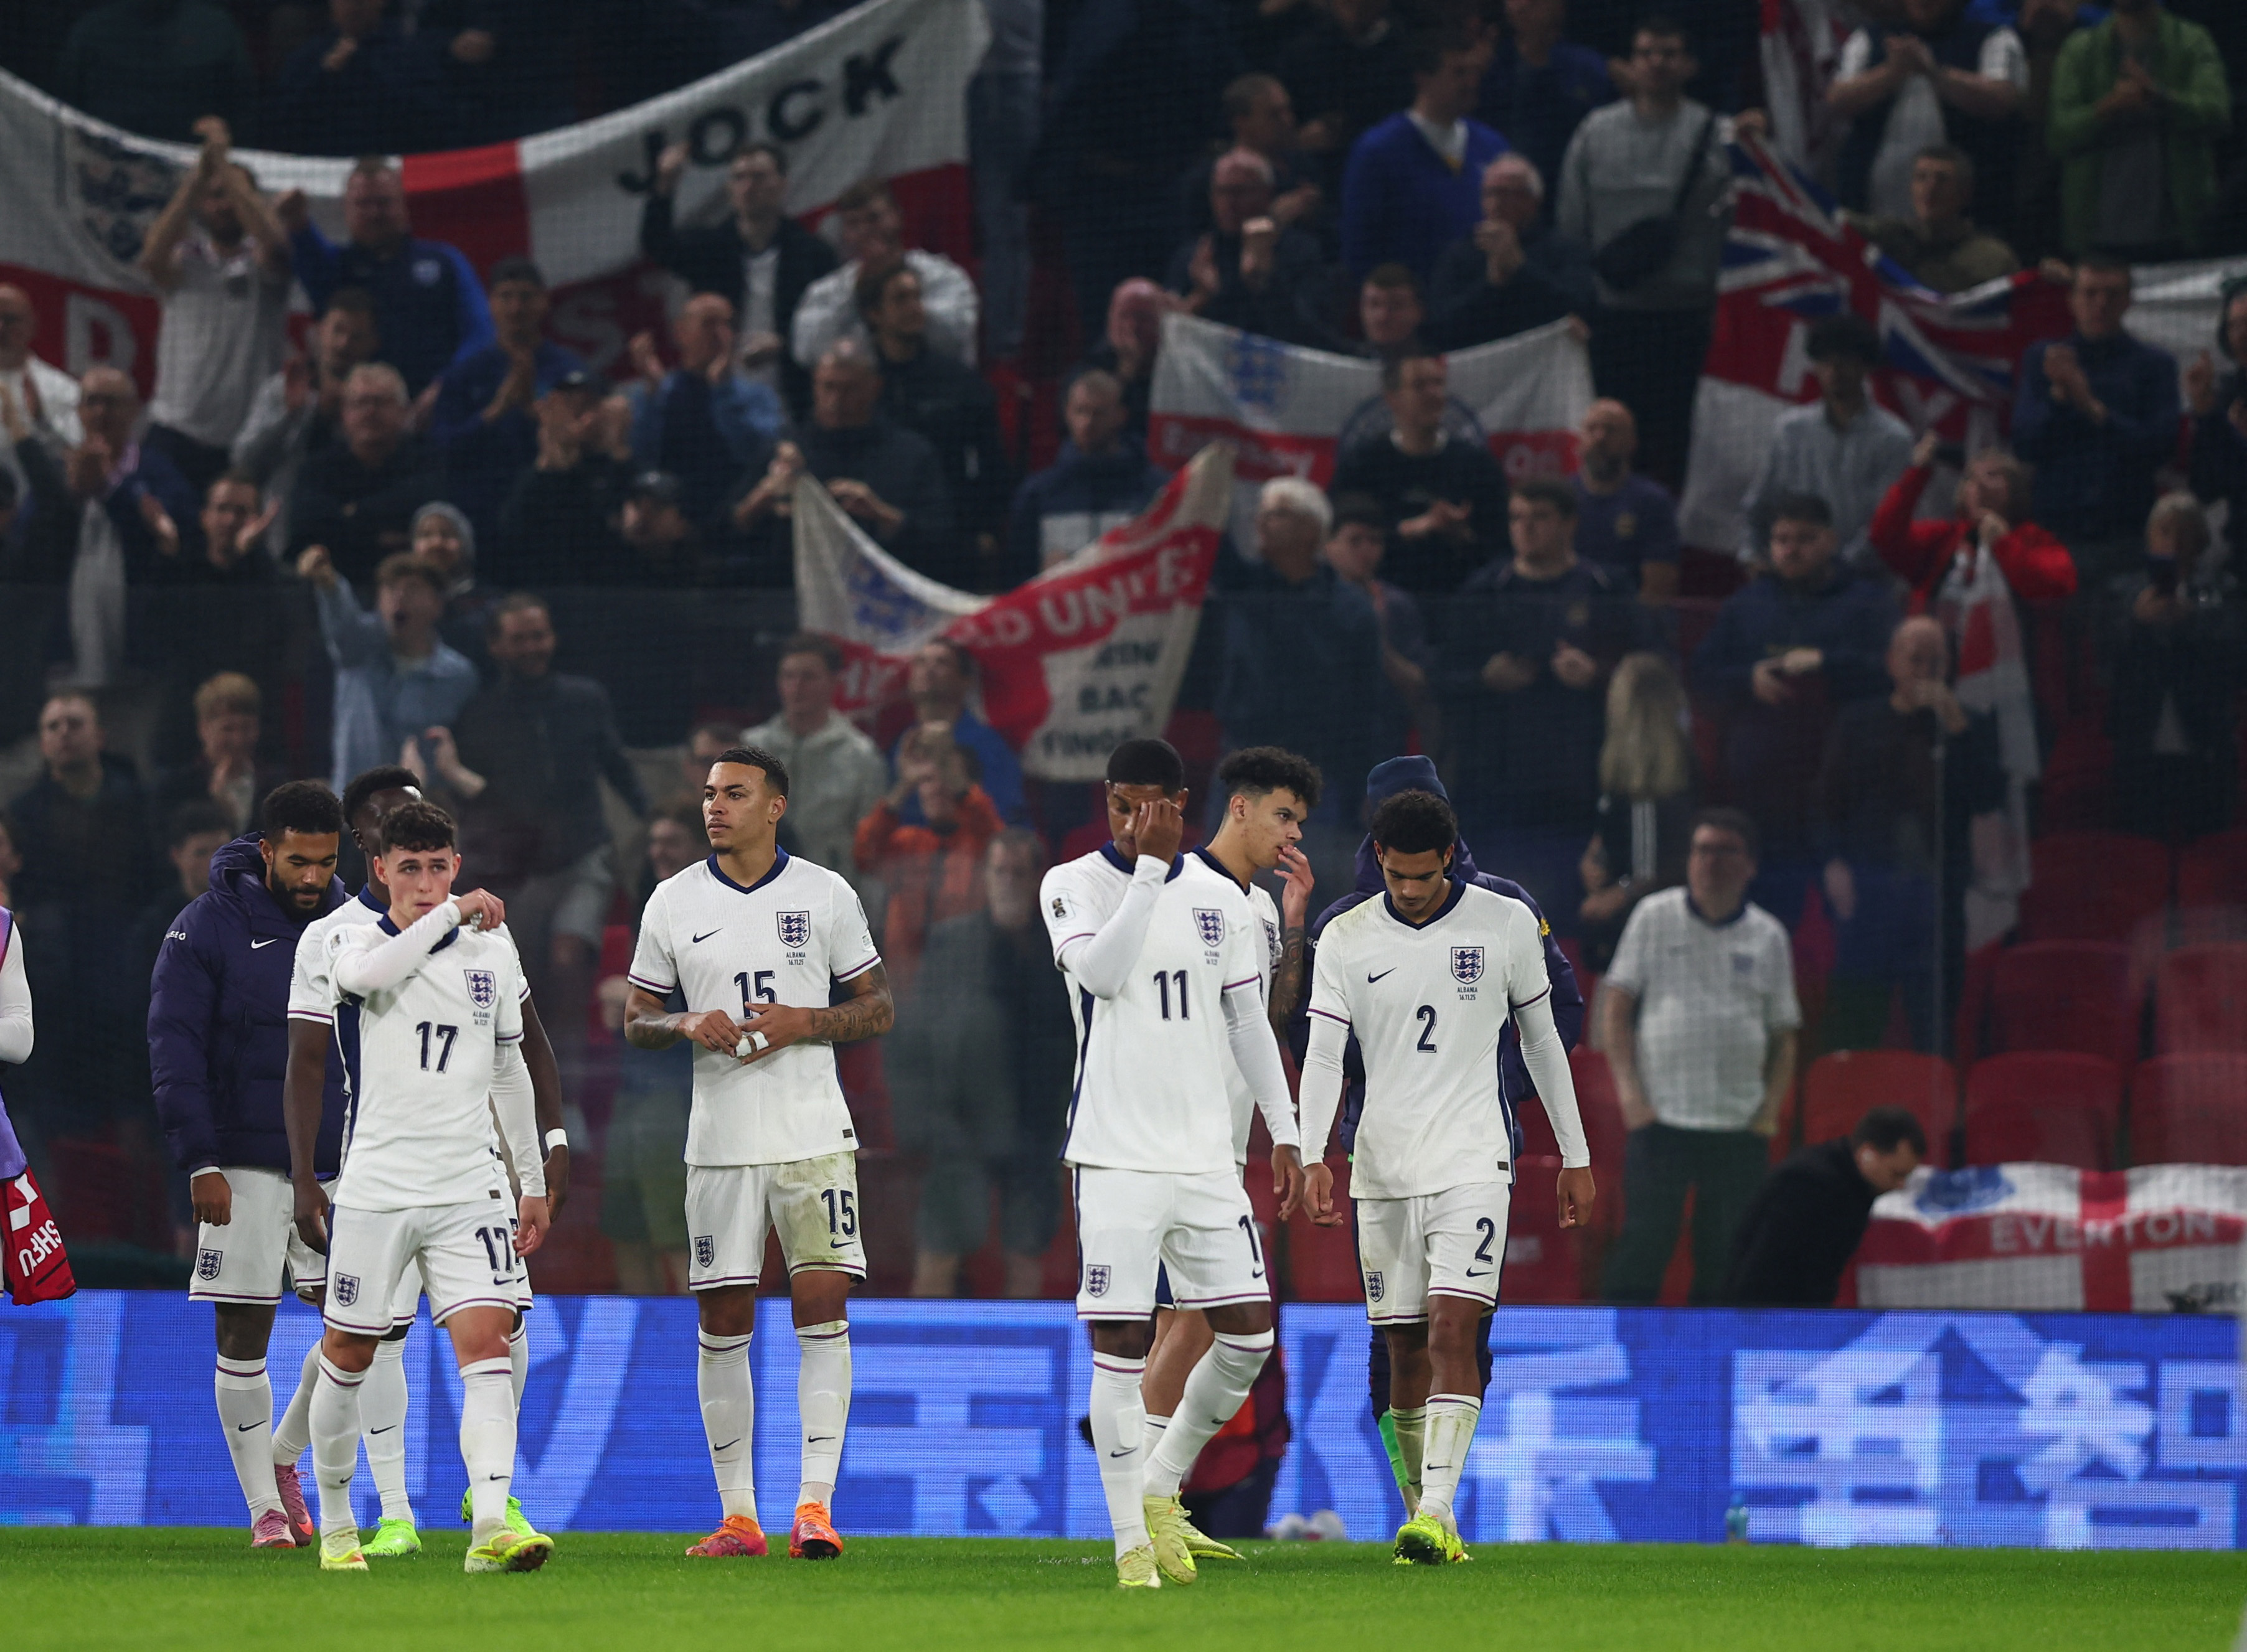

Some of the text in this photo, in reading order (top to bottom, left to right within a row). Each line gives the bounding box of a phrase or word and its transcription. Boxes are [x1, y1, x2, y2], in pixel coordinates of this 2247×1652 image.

[616, 37, 904, 194] JOCK
[734, 970, 777, 1020] 15
[1154, 969, 1190, 1021] 11
[416, 1021, 459, 1074] 17
[1416, 1005, 1437, 1053] 2
[821, 1189, 857, 1237] 15
[1990, 1209, 2218, 1253] EVERTON
[475, 1226, 512, 1274] 17
[1238, 1214, 1260, 1264] 1
[1474, 1217, 1496, 1265] 2
